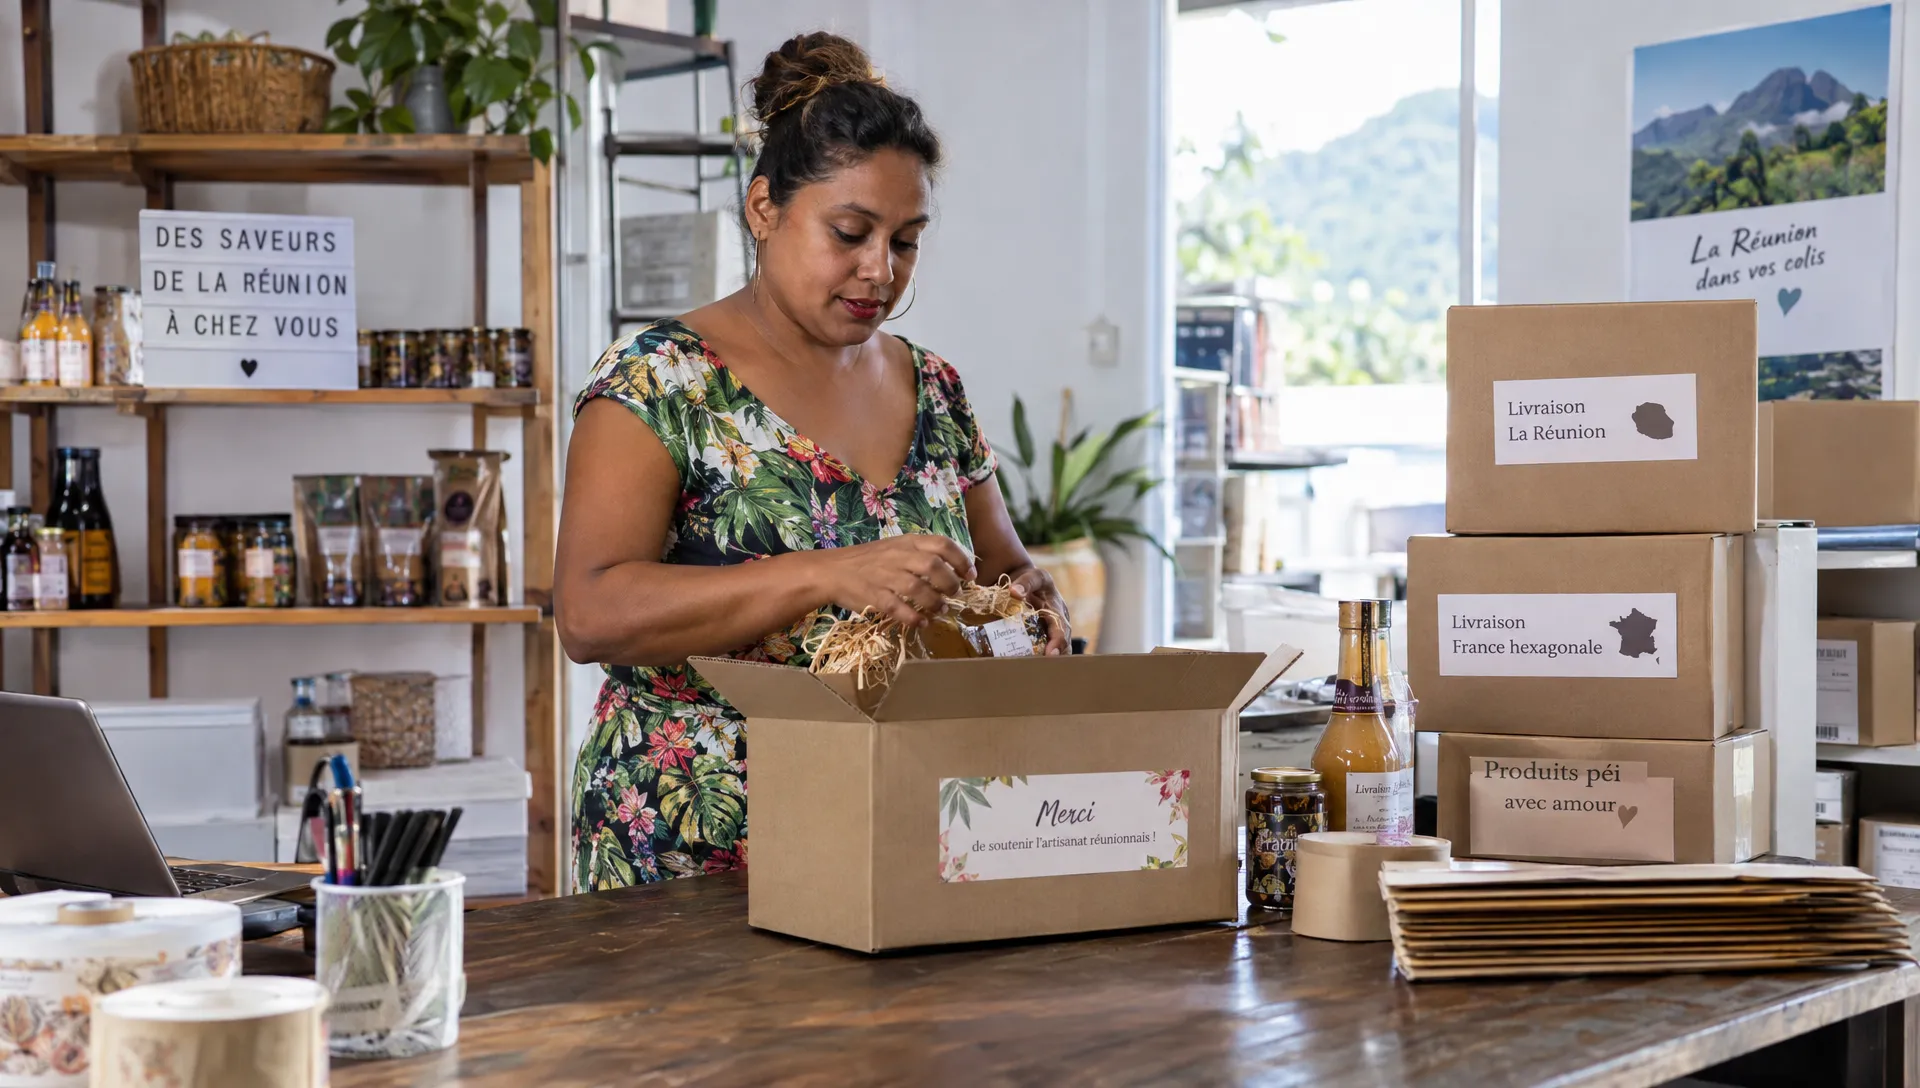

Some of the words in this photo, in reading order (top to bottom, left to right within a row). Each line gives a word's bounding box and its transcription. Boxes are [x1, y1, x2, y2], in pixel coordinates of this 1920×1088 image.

[156, 225, 204, 249] DES
[220, 227, 337, 253] SAVEURS
[1690, 234, 1721, 265] La
[1730, 223, 1818, 257] Réunion
[153, 269, 184, 293] DE
[198, 271, 228, 294] LA
[243, 267, 347, 297] RÉUNION
[1695, 266, 1741, 292] dans
[1748, 261, 1777, 280] vos
[1783, 244, 1826, 272] colis
[166, 308, 180, 336] À
[194, 314, 259, 337] CHEZ
[274, 315, 340, 339] VOUS
[1507, 399, 1586, 416] Livraison
[1507, 426, 1528, 442] La
[1533, 424, 1607, 441] Réunion
[1452, 614, 1526, 630] Livraison
[1452, 639, 1506, 655] France
[1509, 639, 1604, 659] hexagonale
[1484, 760, 1579, 782] Produits
[1585, 763, 1622, 788] péi
[1035, 799, 1096, 828] Merci
[1504, 797, 1548, 811] avec
[1552, 799, 1617, 813] amour
[971, 839, 986, 853] de
[988, 837, 1035, 852] soutenir
[1036, 836, 1089, 850] l'artisanat
[1090, 833, 1151, 846] réunionnais
